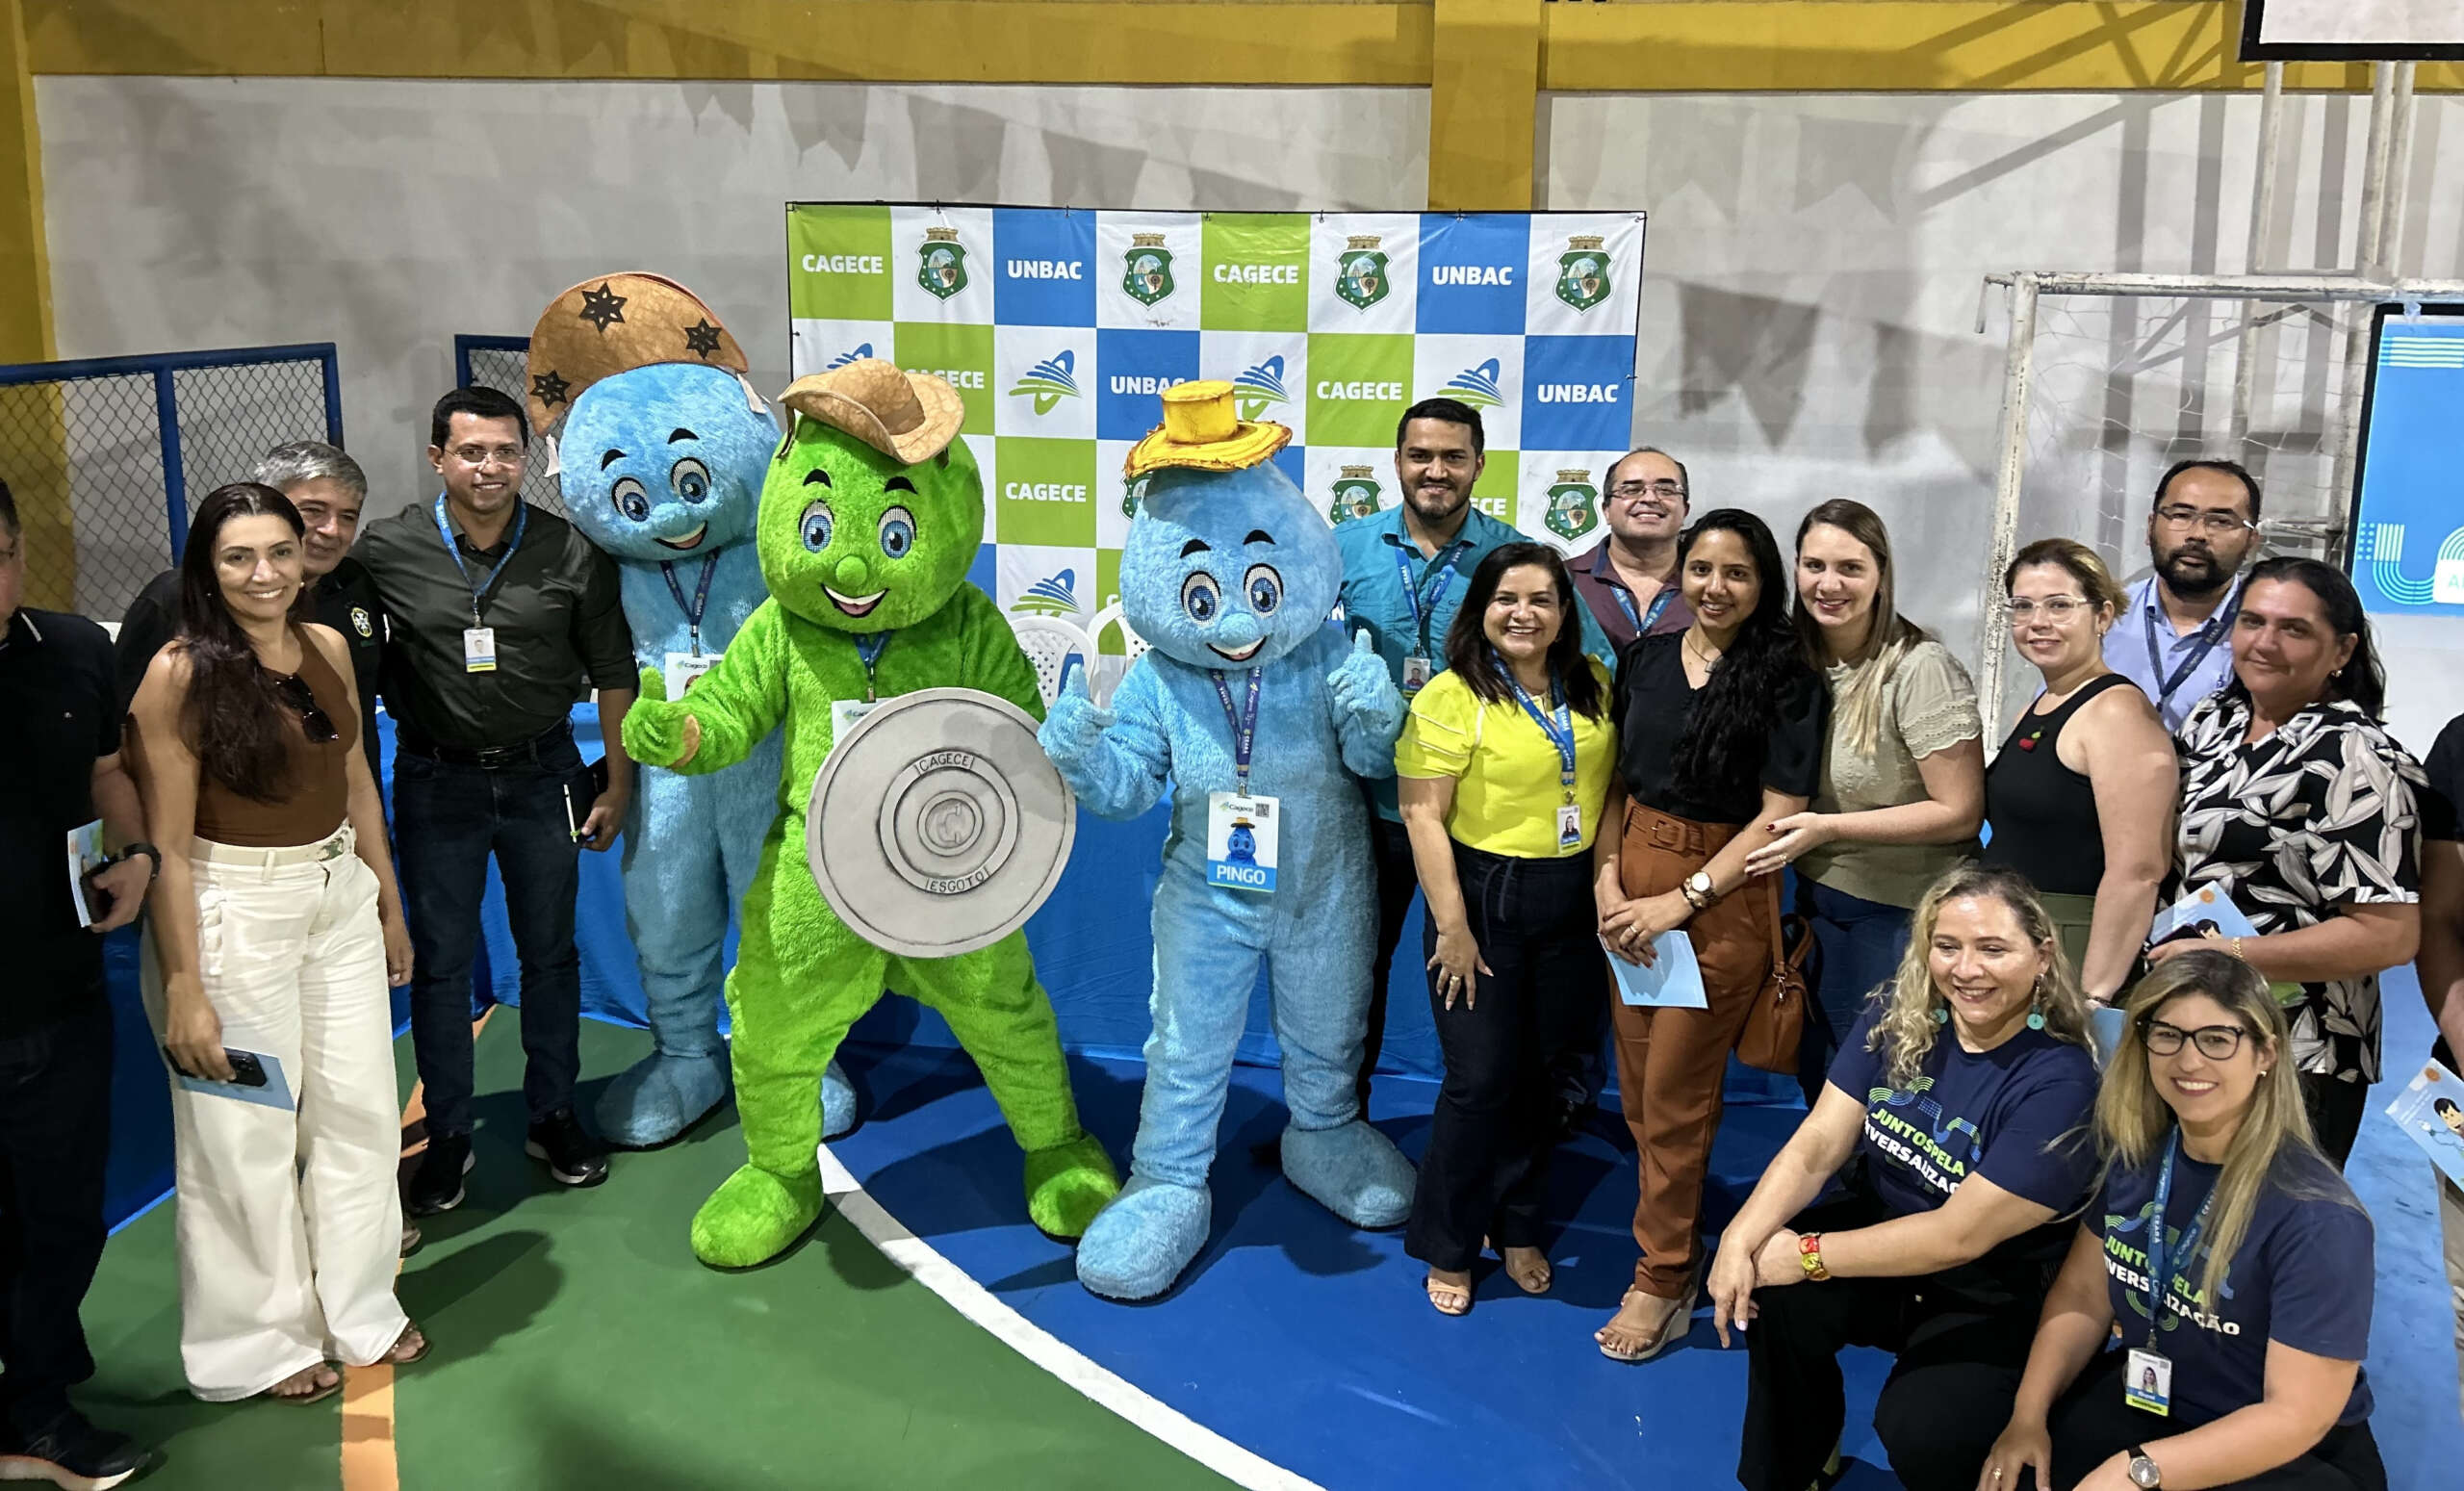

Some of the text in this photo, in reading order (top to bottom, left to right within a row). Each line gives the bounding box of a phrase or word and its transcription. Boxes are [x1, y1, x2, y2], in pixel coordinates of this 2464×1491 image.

[802, 254, 884, 274] CAGECE
[1007, 259, 1083, 280] UNBAC
[1213, 264, 1299, 284] CAGECE
[1431, 266, 1513, 286] UNBAC
[1316, 380, 1402, 400] CAGECE
[1537, 383, 1619, 403] UNBAC
[1005, 481, 1087, 502] CAGECE
[919, 753, 969, 771] CAGECE
[930, 870, 986, 892] ESGOTO
[1216, 864, 1267, 885] PINGO
[2105, 1235, 2149, 1271] JUNT
[2171, 1272, 2210, 1307] ELA
